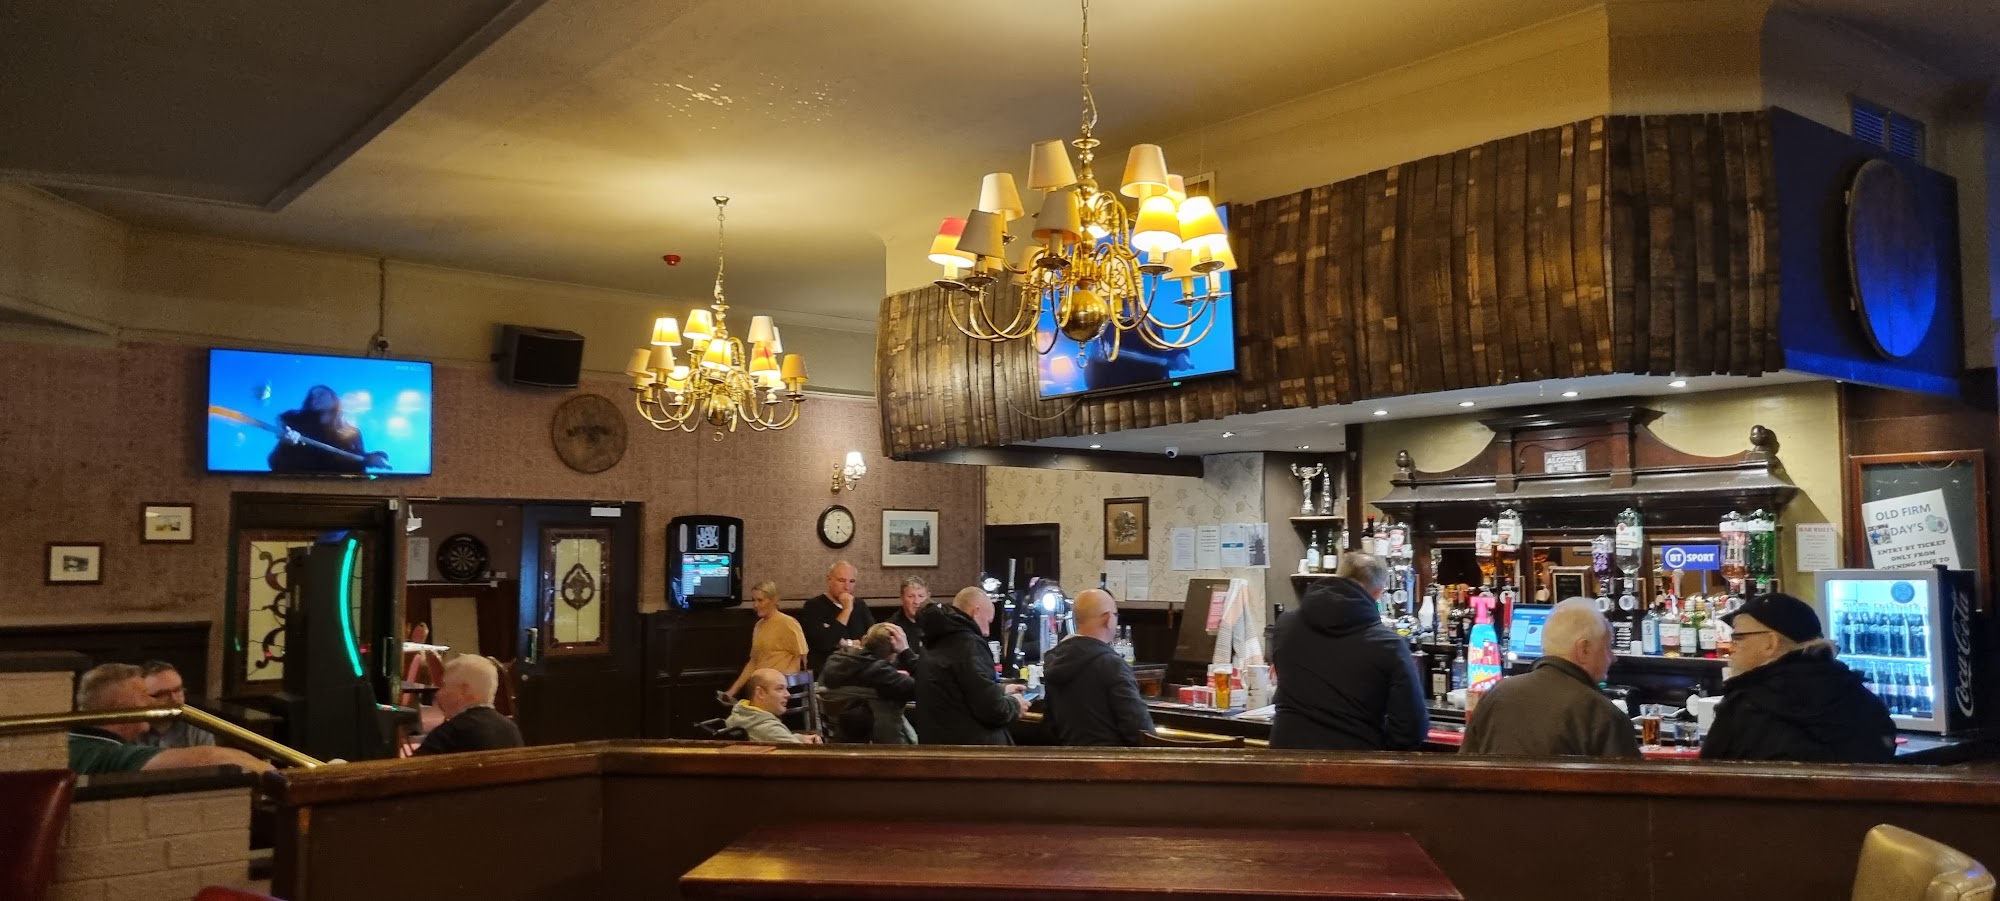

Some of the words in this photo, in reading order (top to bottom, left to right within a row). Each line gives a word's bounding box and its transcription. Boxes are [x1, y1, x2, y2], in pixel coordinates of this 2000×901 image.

[1876, 509, 1898, 521] OLD
[1902, 504, 1931, 516] FIRM
[1890, 522, 1924, 536] DAY'S
[1877, 546, 1903, 555] ENTRY
[1918, 540, 1946, 550] TICKET
[1686, 553, 1714, 562] SPORT
[1891, 554, 1912, 562] ONLY
[1914, 550, 1936, 558] FROM
[1918, 558, 1937, 566] TIME
